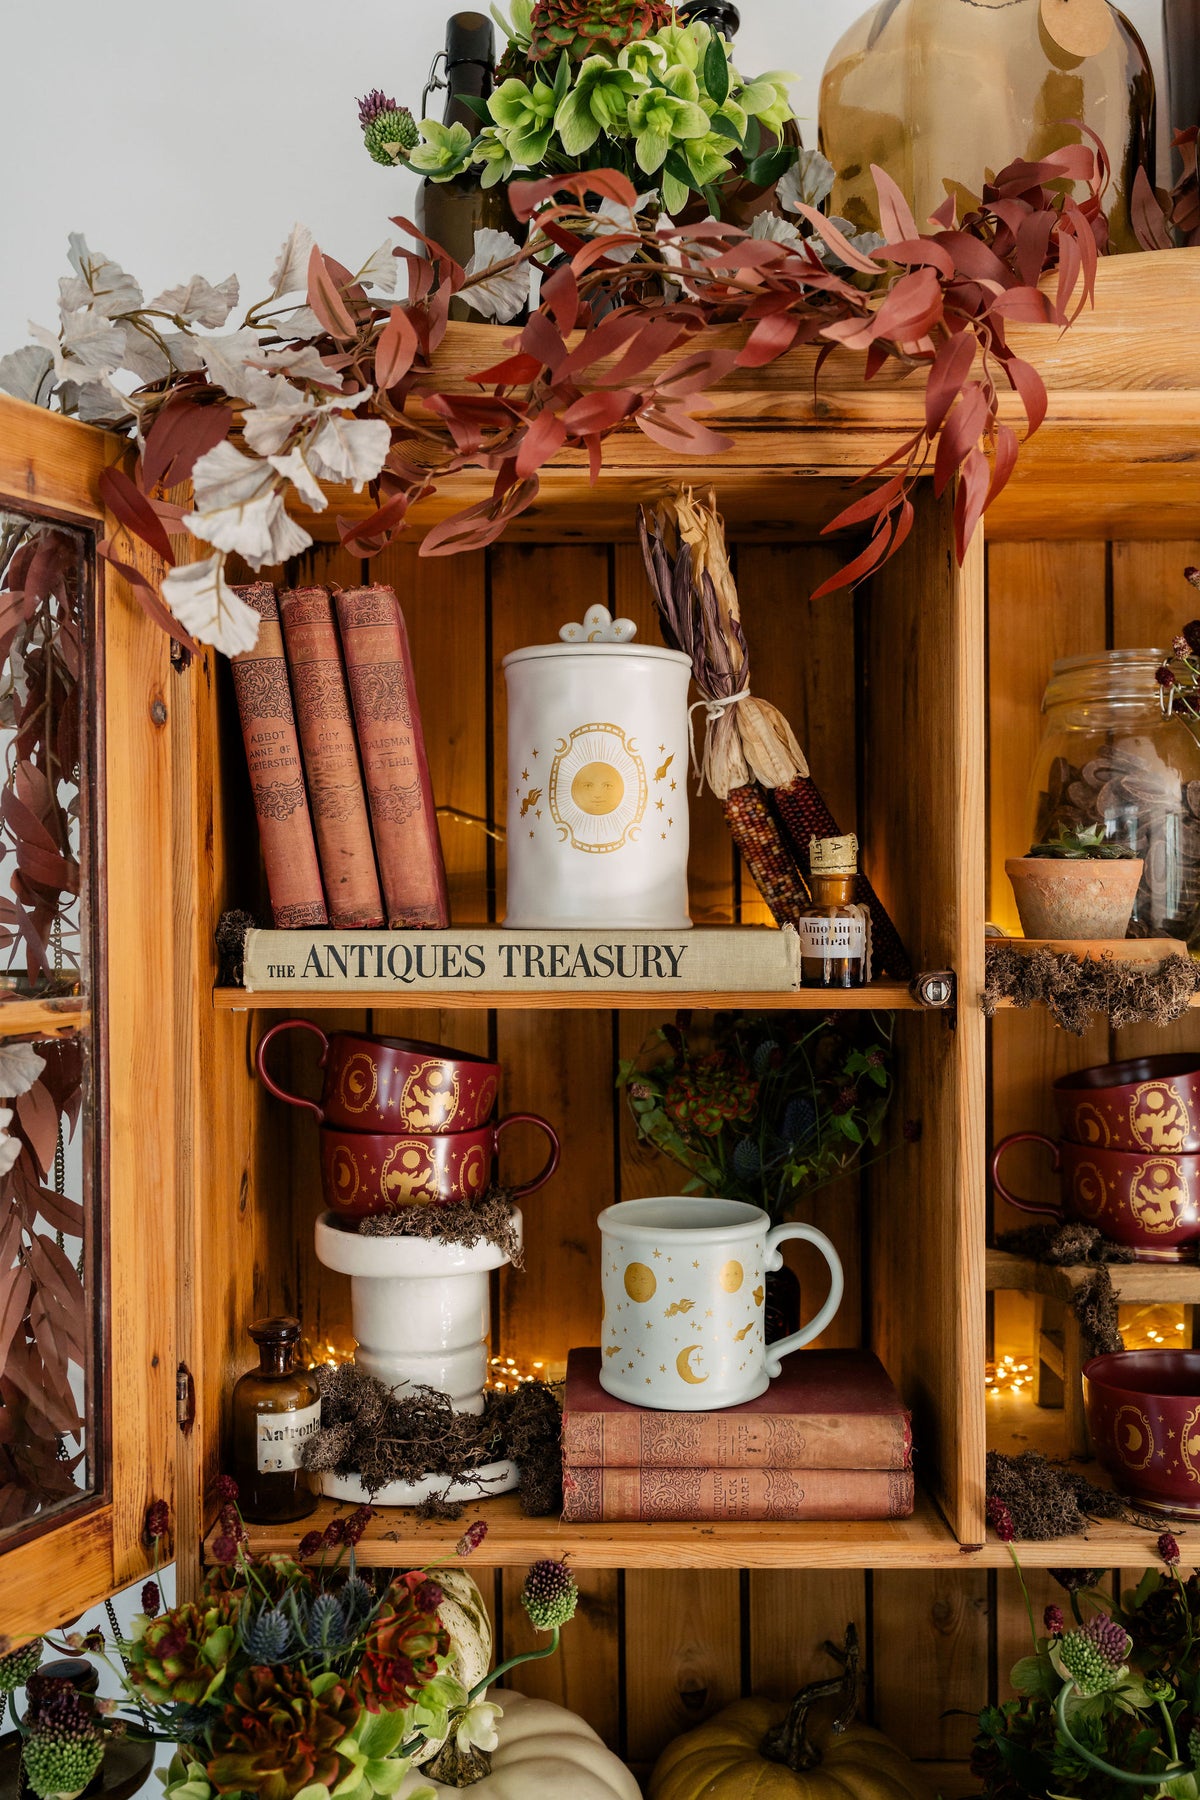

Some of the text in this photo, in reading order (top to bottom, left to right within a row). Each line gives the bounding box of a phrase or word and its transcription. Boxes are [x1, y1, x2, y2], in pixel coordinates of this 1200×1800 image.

[250, 730, 286, 744] ABBOT
[318, 731, 339, 743] GUY
[364, 736, 411, 751] TALISMAN
[250, 744, 292, 760] ANNE OF
[249, 756, 297, 772] GEIERSTEIN
[267, 943, 688, 984] THE ANTIQUES TREASURY
[728, 1479, 737, 1515] BLACK
[740, 1476, 750, 1516] DWARF
